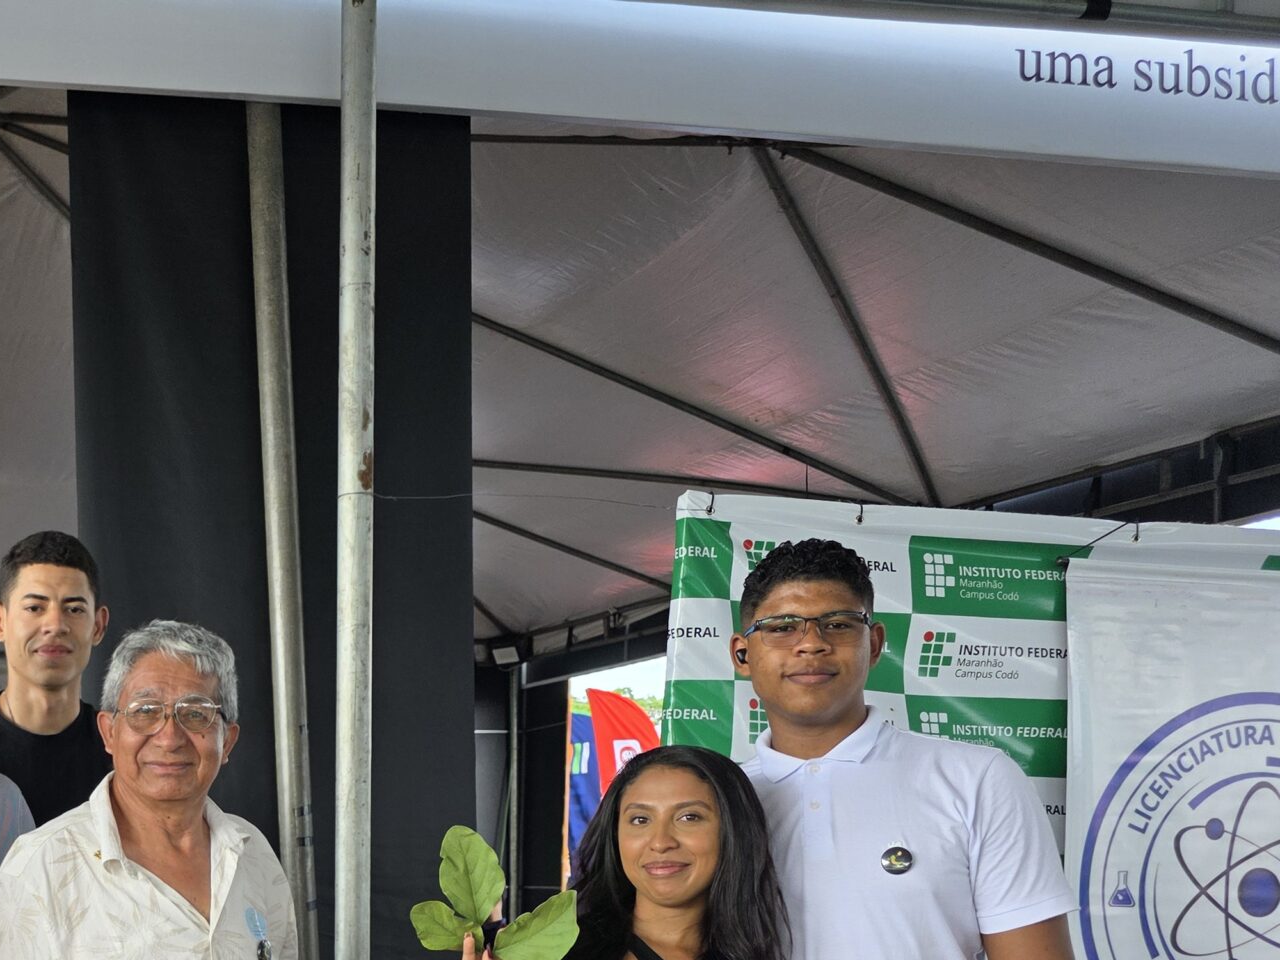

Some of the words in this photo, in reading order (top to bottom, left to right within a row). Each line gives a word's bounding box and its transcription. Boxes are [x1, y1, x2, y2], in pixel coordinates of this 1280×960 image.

[1015, 48, 1117, 89] uma
[1133, 48, 1280, 105] subsid
[959, 566, 1022, 579] INSTITUTO
[959, 579, 1004, 589] Maranhão
[960, 590, 995, 601] Campus
[996, 590, 1019, 601] Codó
[958, 645, 1024, 658] INSTITUTO
[956, 658, 1004, 669] Maranhão
[954, 669, 993, 680] Campus
[995, 670, 1020, 680] Codó
[952, 724, 1014, 737] INSTITUTO
[1128, 725, 1275, 834] LICENCIATURA
